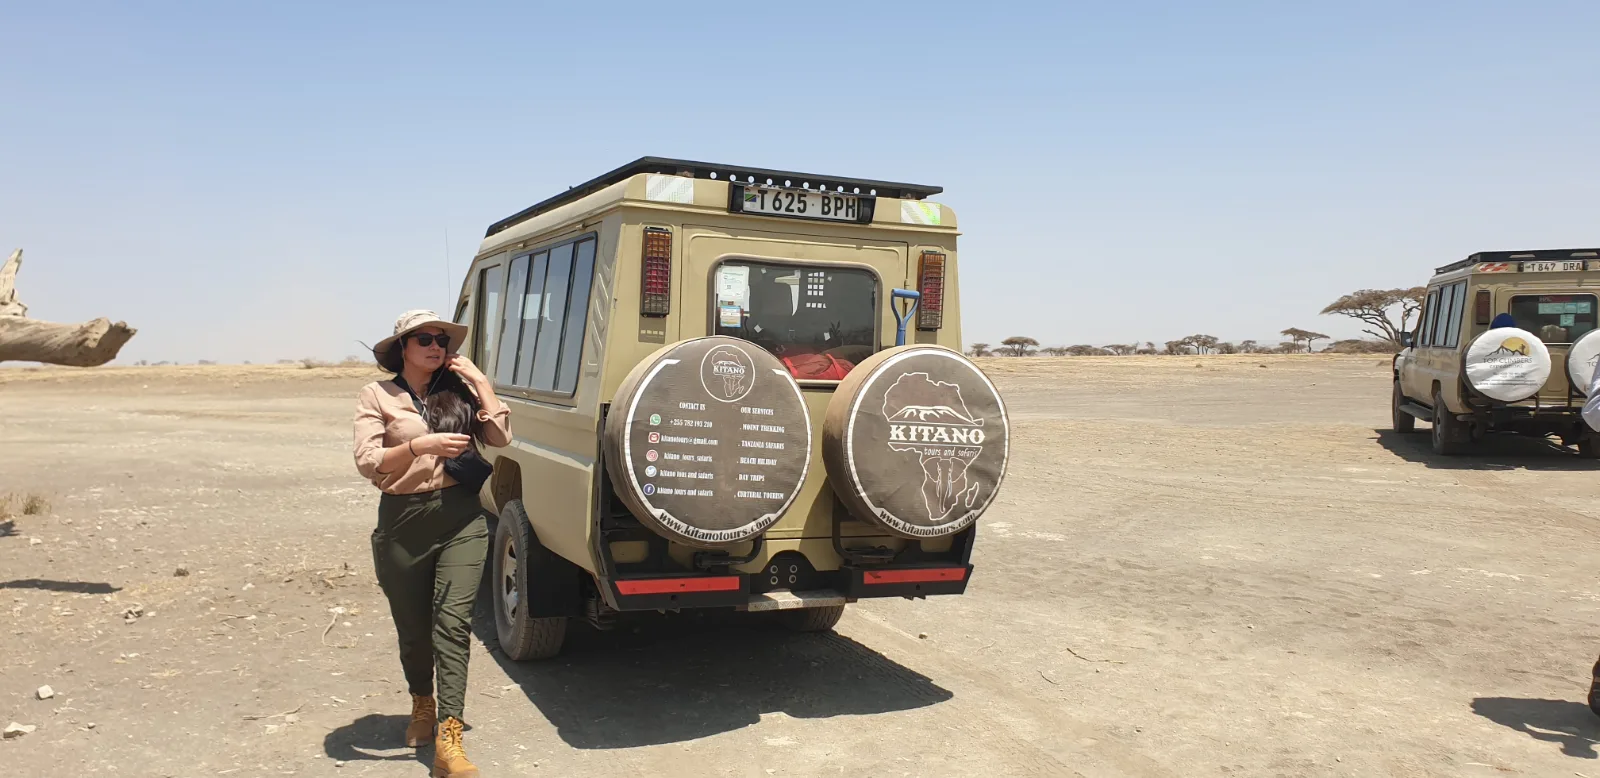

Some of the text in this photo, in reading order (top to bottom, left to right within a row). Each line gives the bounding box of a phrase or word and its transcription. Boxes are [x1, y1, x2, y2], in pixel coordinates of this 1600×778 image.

[758, 190, 856, 218] T 625 BPH
[1531, 262, 1582, 271] T 847 DRA
[713, 365, 745, 375] KITANO
[679, 402, 706, 411] CONTACT US
[740, 406, 774, 416] OUR SERVICES
[742, 423, 760, 431] MOUNT
[889, 424, 986, 445] KITANO
[741, 440, 785, 450] TANZANIA SAFARIS
[924, 446, 978, 458] tours and safaris
[740, 456, 757, 465] BEACH
[660, 469, 676, 477] kitano
[687, 471, 697, 479] and
[697, 472, 714, 480] safaris
[738, 473, 765, 482] DAY TRIPS
[687, 488, 697, 496] and
[697, 489, 714, 497] safaris
[763, 491, 785, 500] TOURISM
[659, 512, 772, 541] www.kitanotours.com
[879, 510, 976, 536] www.kitanotours.com
